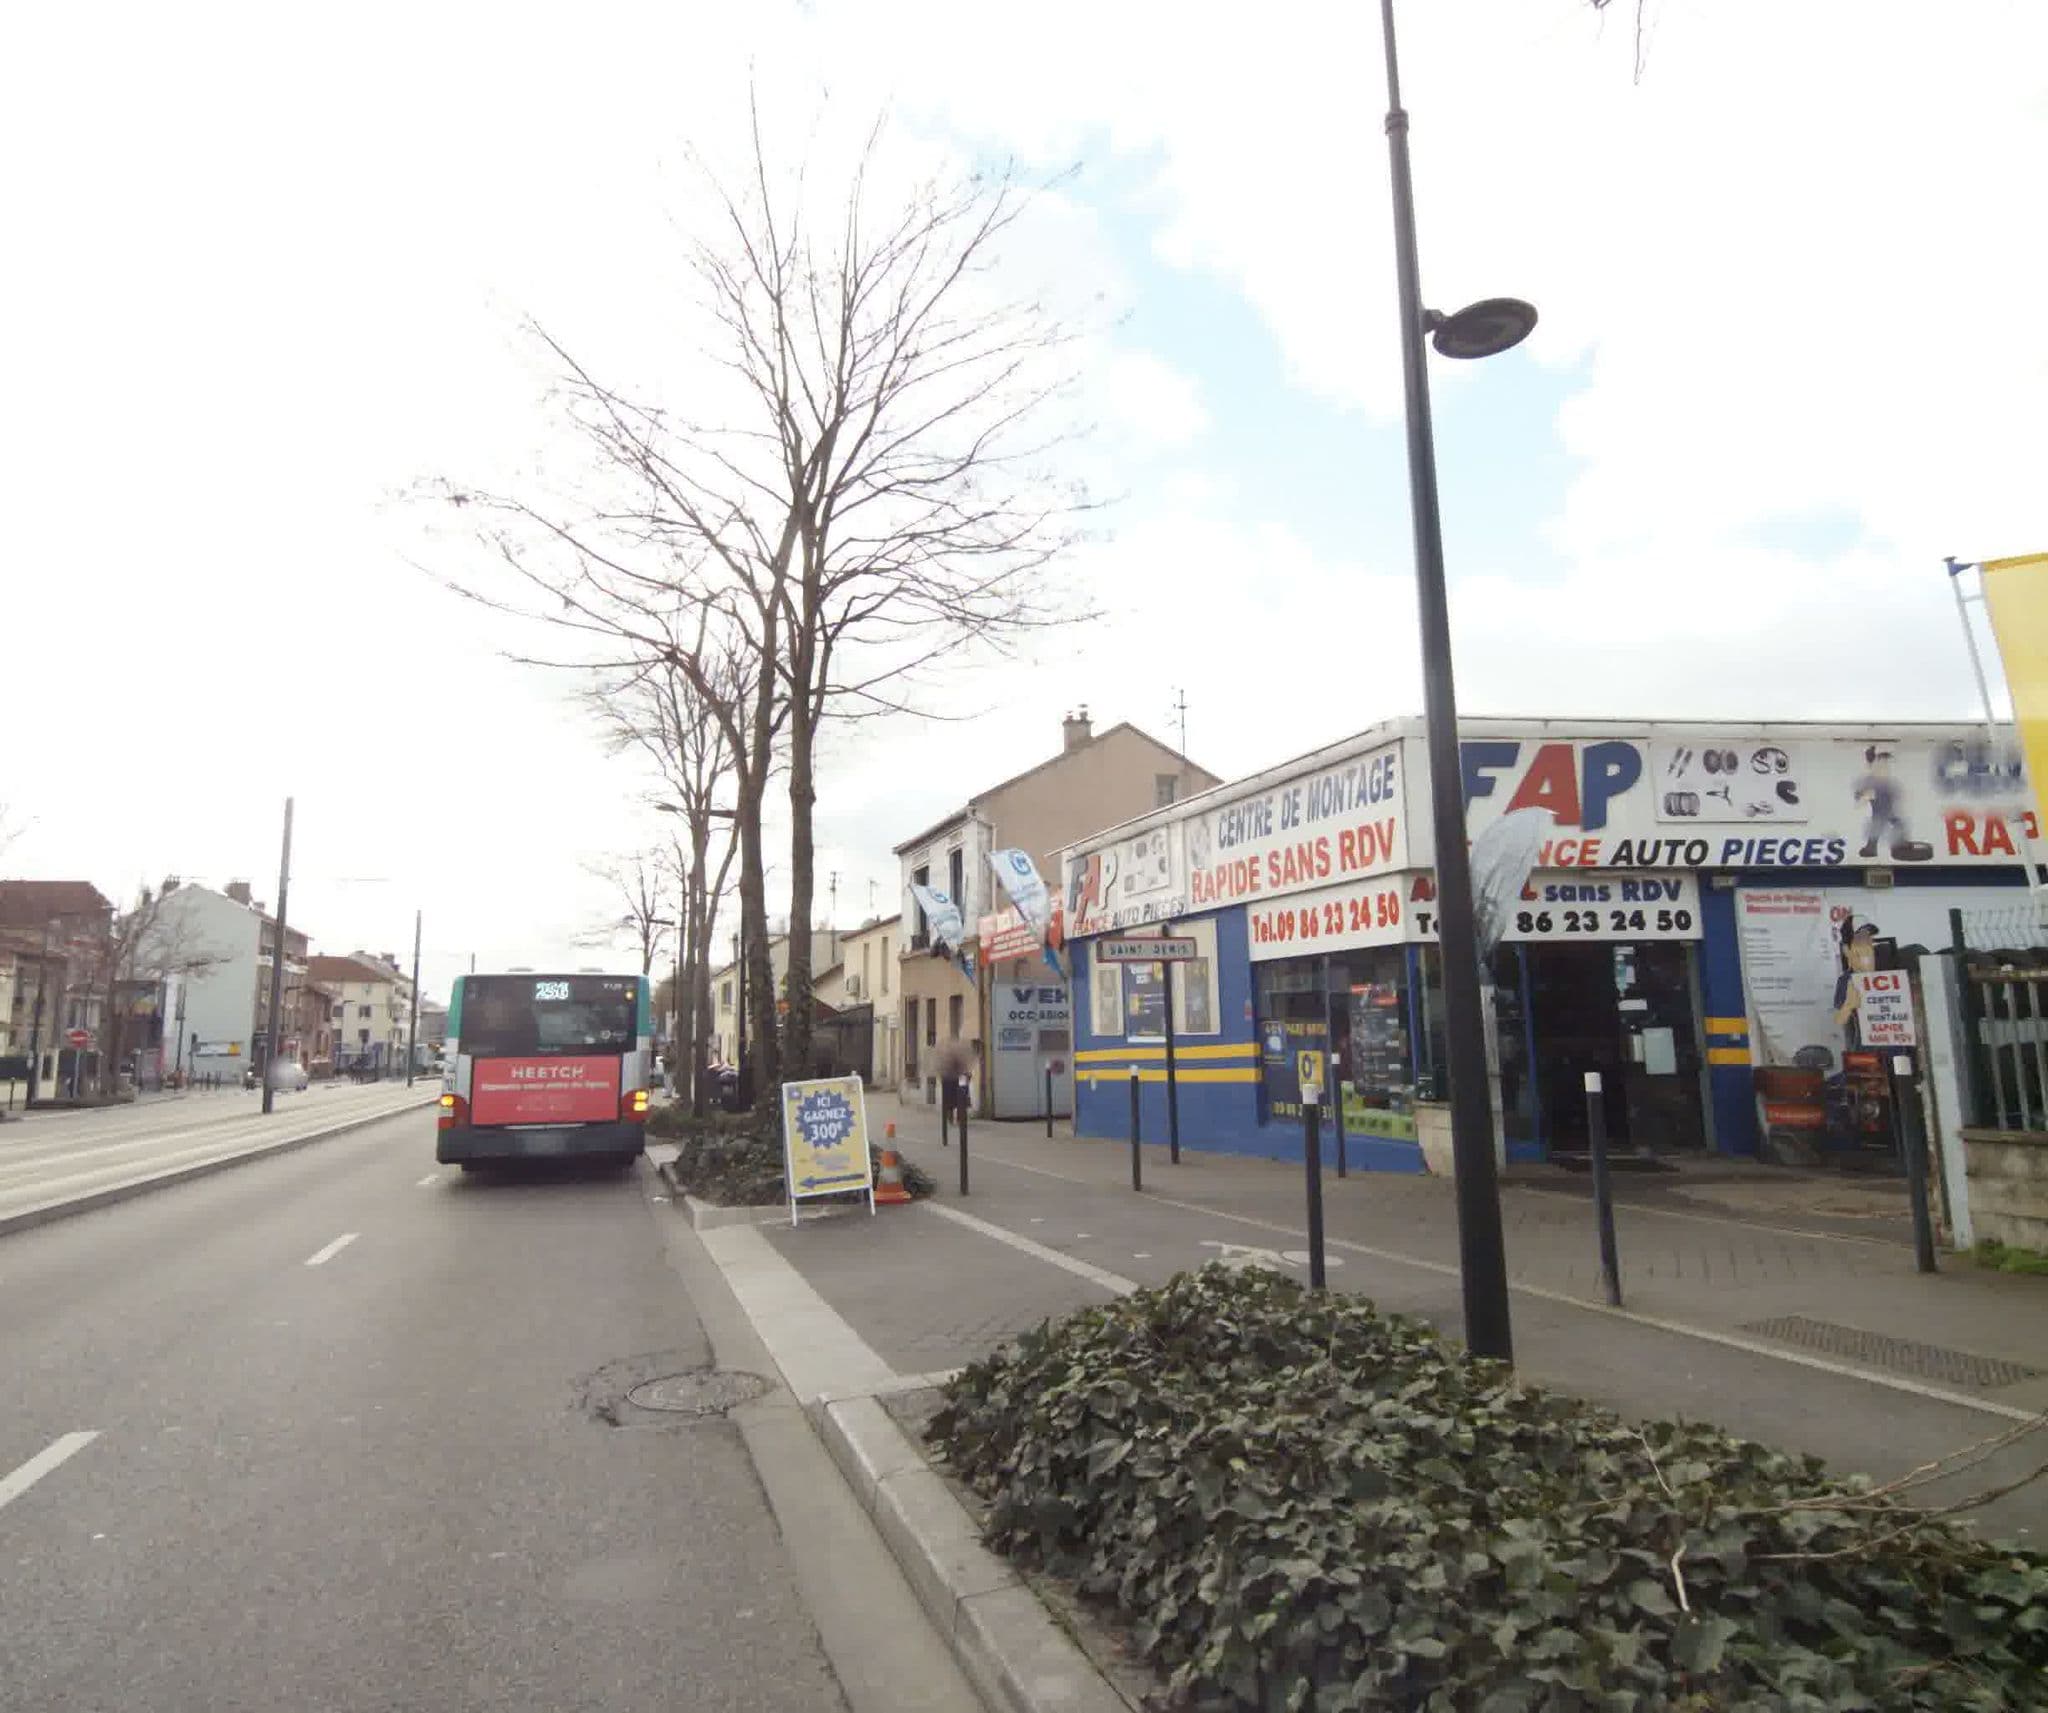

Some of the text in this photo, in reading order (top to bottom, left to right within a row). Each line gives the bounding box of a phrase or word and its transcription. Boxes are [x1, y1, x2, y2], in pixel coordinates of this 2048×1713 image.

[1460, 741, 1643, 831] FAP
[1218, 754, 1395, 849] CENTRE DE MONTAGE
[1191, 816, 1395, 904] RAPIDE SANS RDV
[1608, 839, 1709, 866] AUTO
[1720, 838, 1847, 866] PIECES
[1069, 850, 1119, 923] FAP
[1545, 882, 1611, 902] sans
[1621, 879, 1682, 902] RDV
[1112, 904, 1141, 928] AUTO
[1143, 896, 1185, 921] PIECES
[1300, 906, 1319, 939] 86
[1324, 901, 1344, 935] 23
[1350, 896, 1372, 931] 24
[1377, 890, 1400, 928] 50
[1516, 910, 1692, 933] 86 23 24 50
[1863, 974, 1901, 991] ICI
[511, 1065, 584, 1079] HEETCH
[803, 1108, 847, 1122] GAGNEZ
[817, 1096, 831, 1107] ICI
